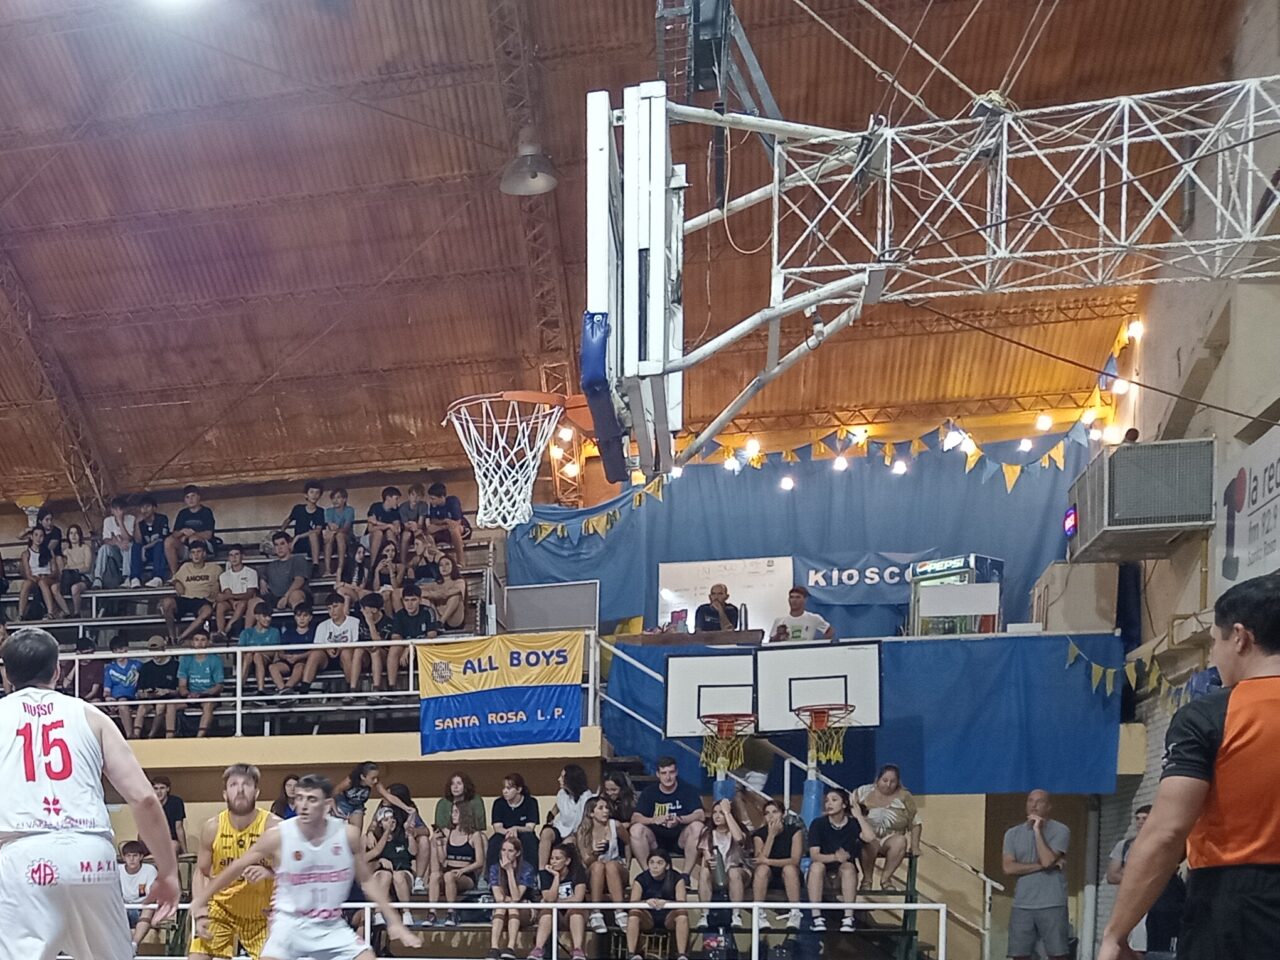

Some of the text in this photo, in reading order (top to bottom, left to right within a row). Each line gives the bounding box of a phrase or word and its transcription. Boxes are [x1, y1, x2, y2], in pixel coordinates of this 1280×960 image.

[1248, 467, 1259, 508] la
[927, 557, 965, 573] PEPSI
[463, 649, 568, 675] ALL BOYS
[435, 715, 479, 730] SANTA
[488, 711, 527, 724] ROSA
[16, 720, 73, 782] 15
